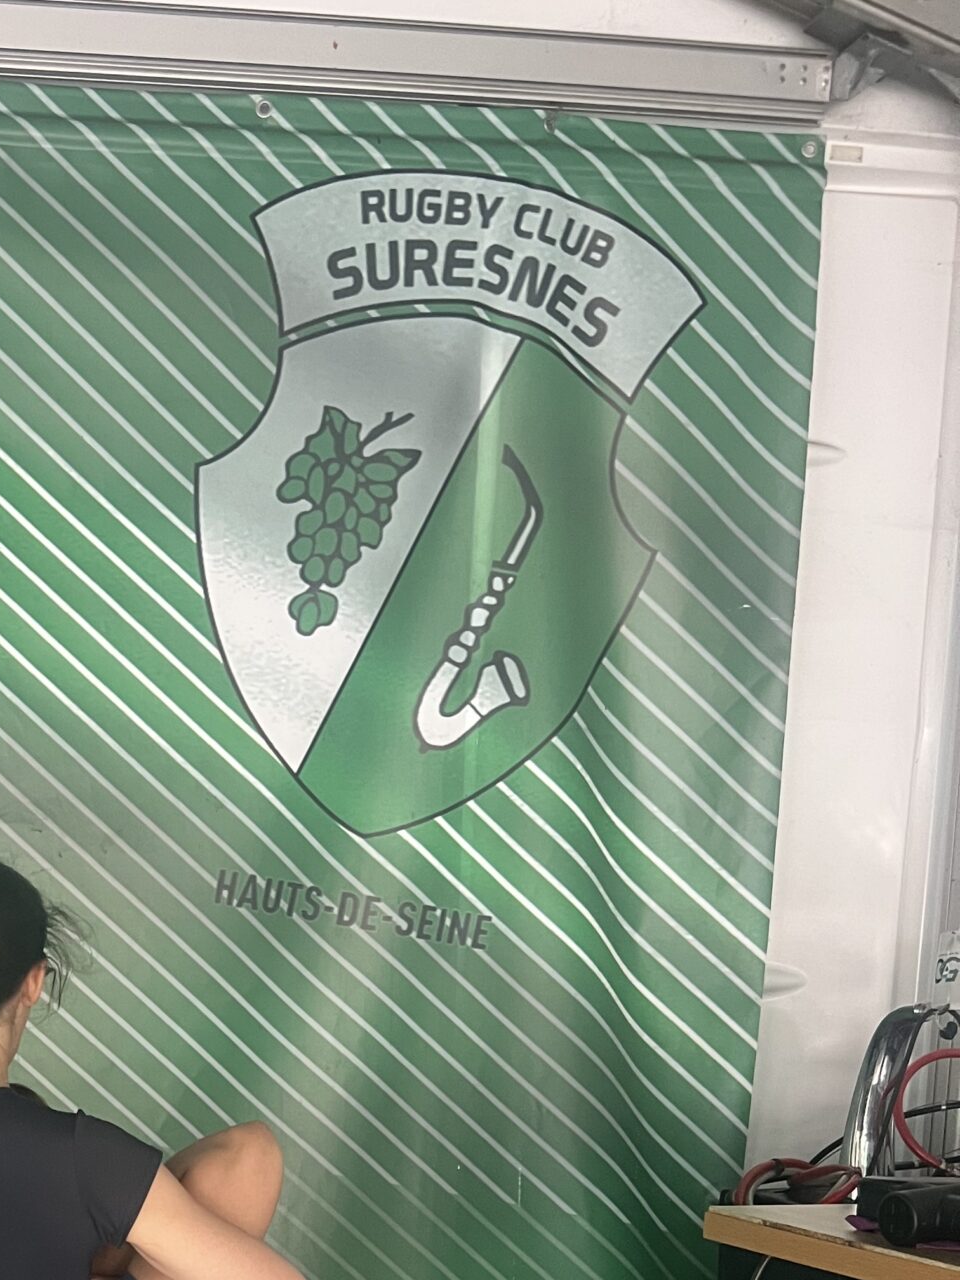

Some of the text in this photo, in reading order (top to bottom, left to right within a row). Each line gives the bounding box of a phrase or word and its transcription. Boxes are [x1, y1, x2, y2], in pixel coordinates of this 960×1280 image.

[360, 188, 616, 269] RUGBY CLUB
[326, 239, 620, 349] SURESNES
[214, 869, 493, 950] HAUTS-DE-SEINE
